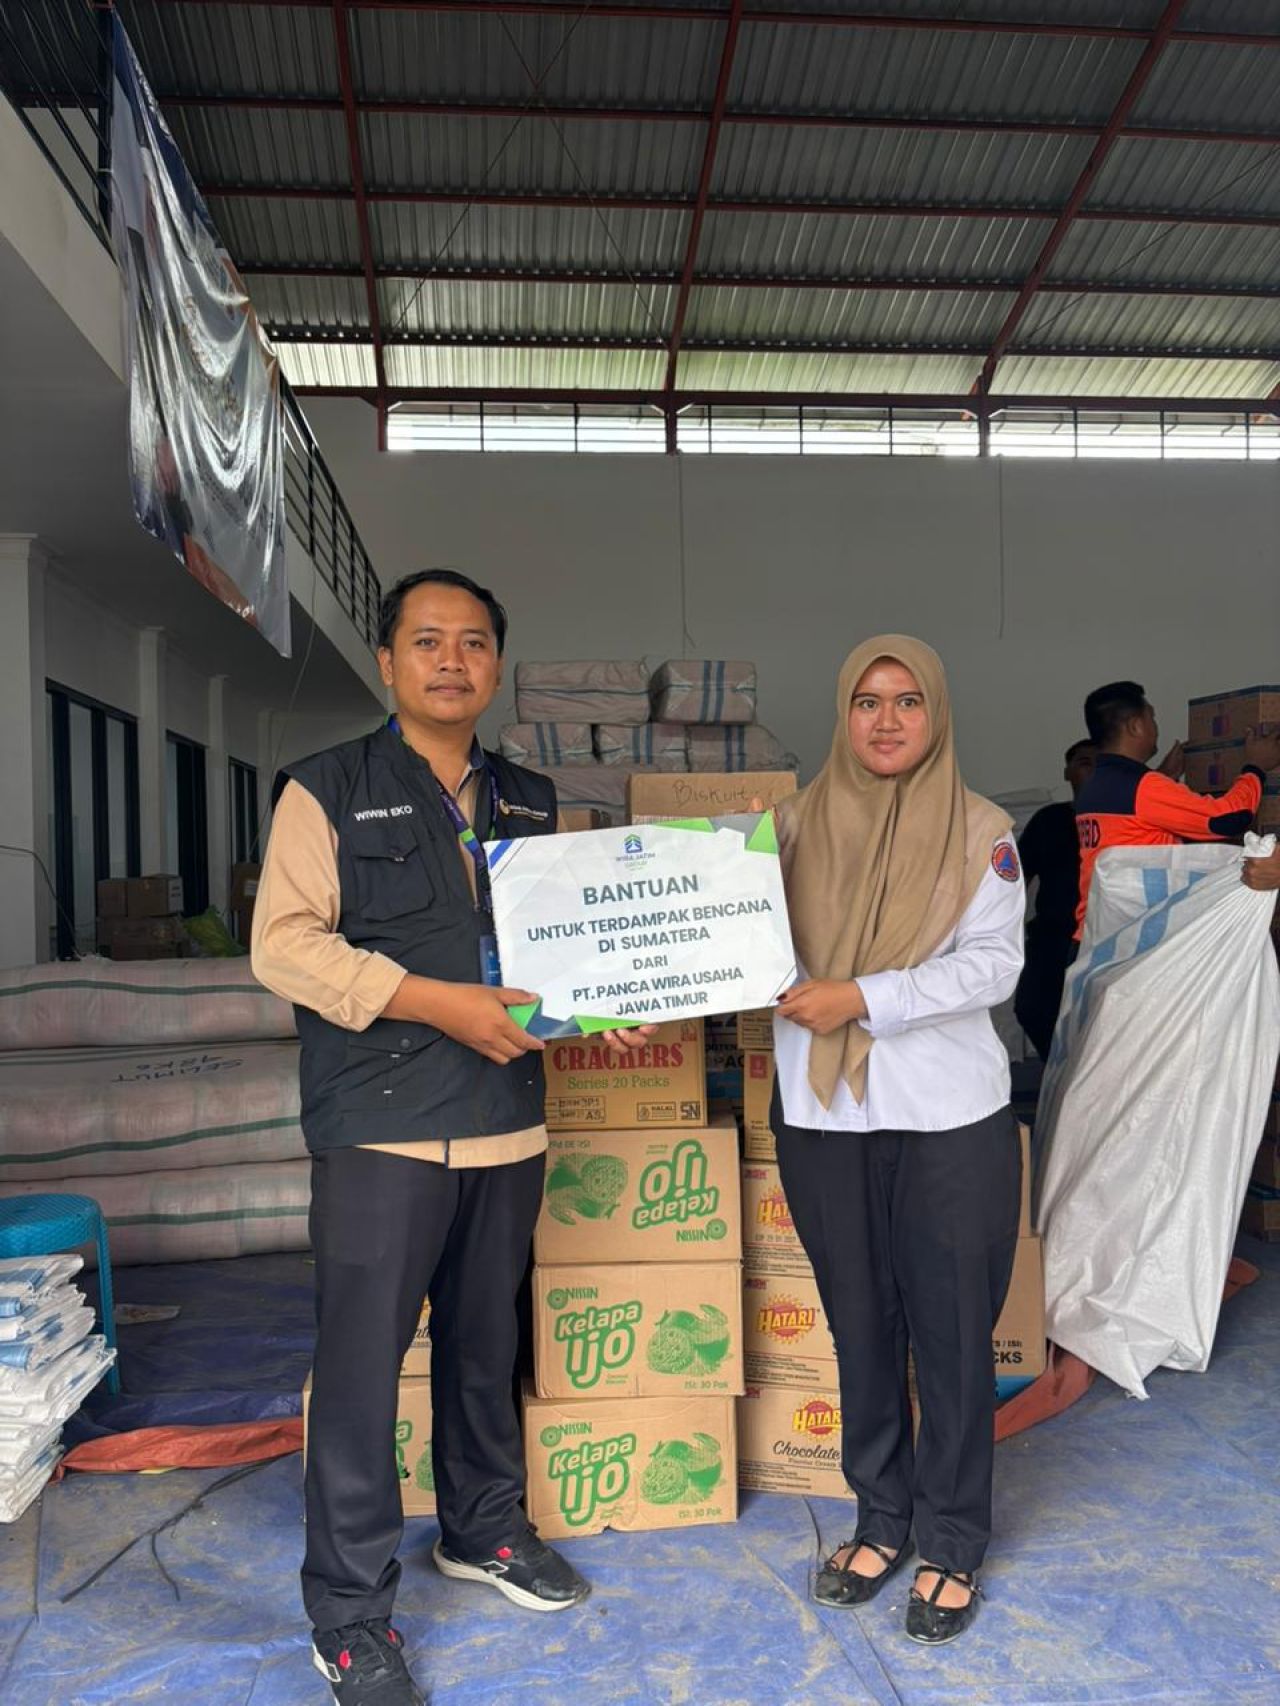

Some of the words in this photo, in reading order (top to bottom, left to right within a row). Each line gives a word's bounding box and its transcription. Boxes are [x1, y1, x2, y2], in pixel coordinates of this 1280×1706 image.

[354, 809, 389, 821] WIWIN
[391, 805, 413, 817] EKO
[582, 873, 699, 905] BANTUAN
[527, 921, 586, 942] UNTUK
[588, 908, 690, 935] TERDAMPAK
[692, 898, 772, 921] BENCANA
[598, 938, 616, 953] DI
[620, 926, 711, 950] SUMATERA
[632, 955, 668, 970] DARI
[596, 978, 650, 999] PANCA
[651, 974, 692, 991] WIRA
[692, 967, 744, 985] USAHA
[615, 997, 662, 1016] JAWA
[662, 991, 709, 1009] TIMUR
[567, 1076, 609, 1090] Series
[612, 1075, 628, 1088] 20
[631, 1074, 670, 1088] Packs
[632, 1187, 718, 1229] Kelapa
[564, 1287, 598, 1299] NISSIN
[556, 1301, 641, 1341] Kelapa
[757, 1308, 817, 1334] HATARI
[792, 1407, 841, 1434] HATAR
[549, 1434, 635, 1479] Kelapa
[772, 1440, 841, 1460] Chocolate
